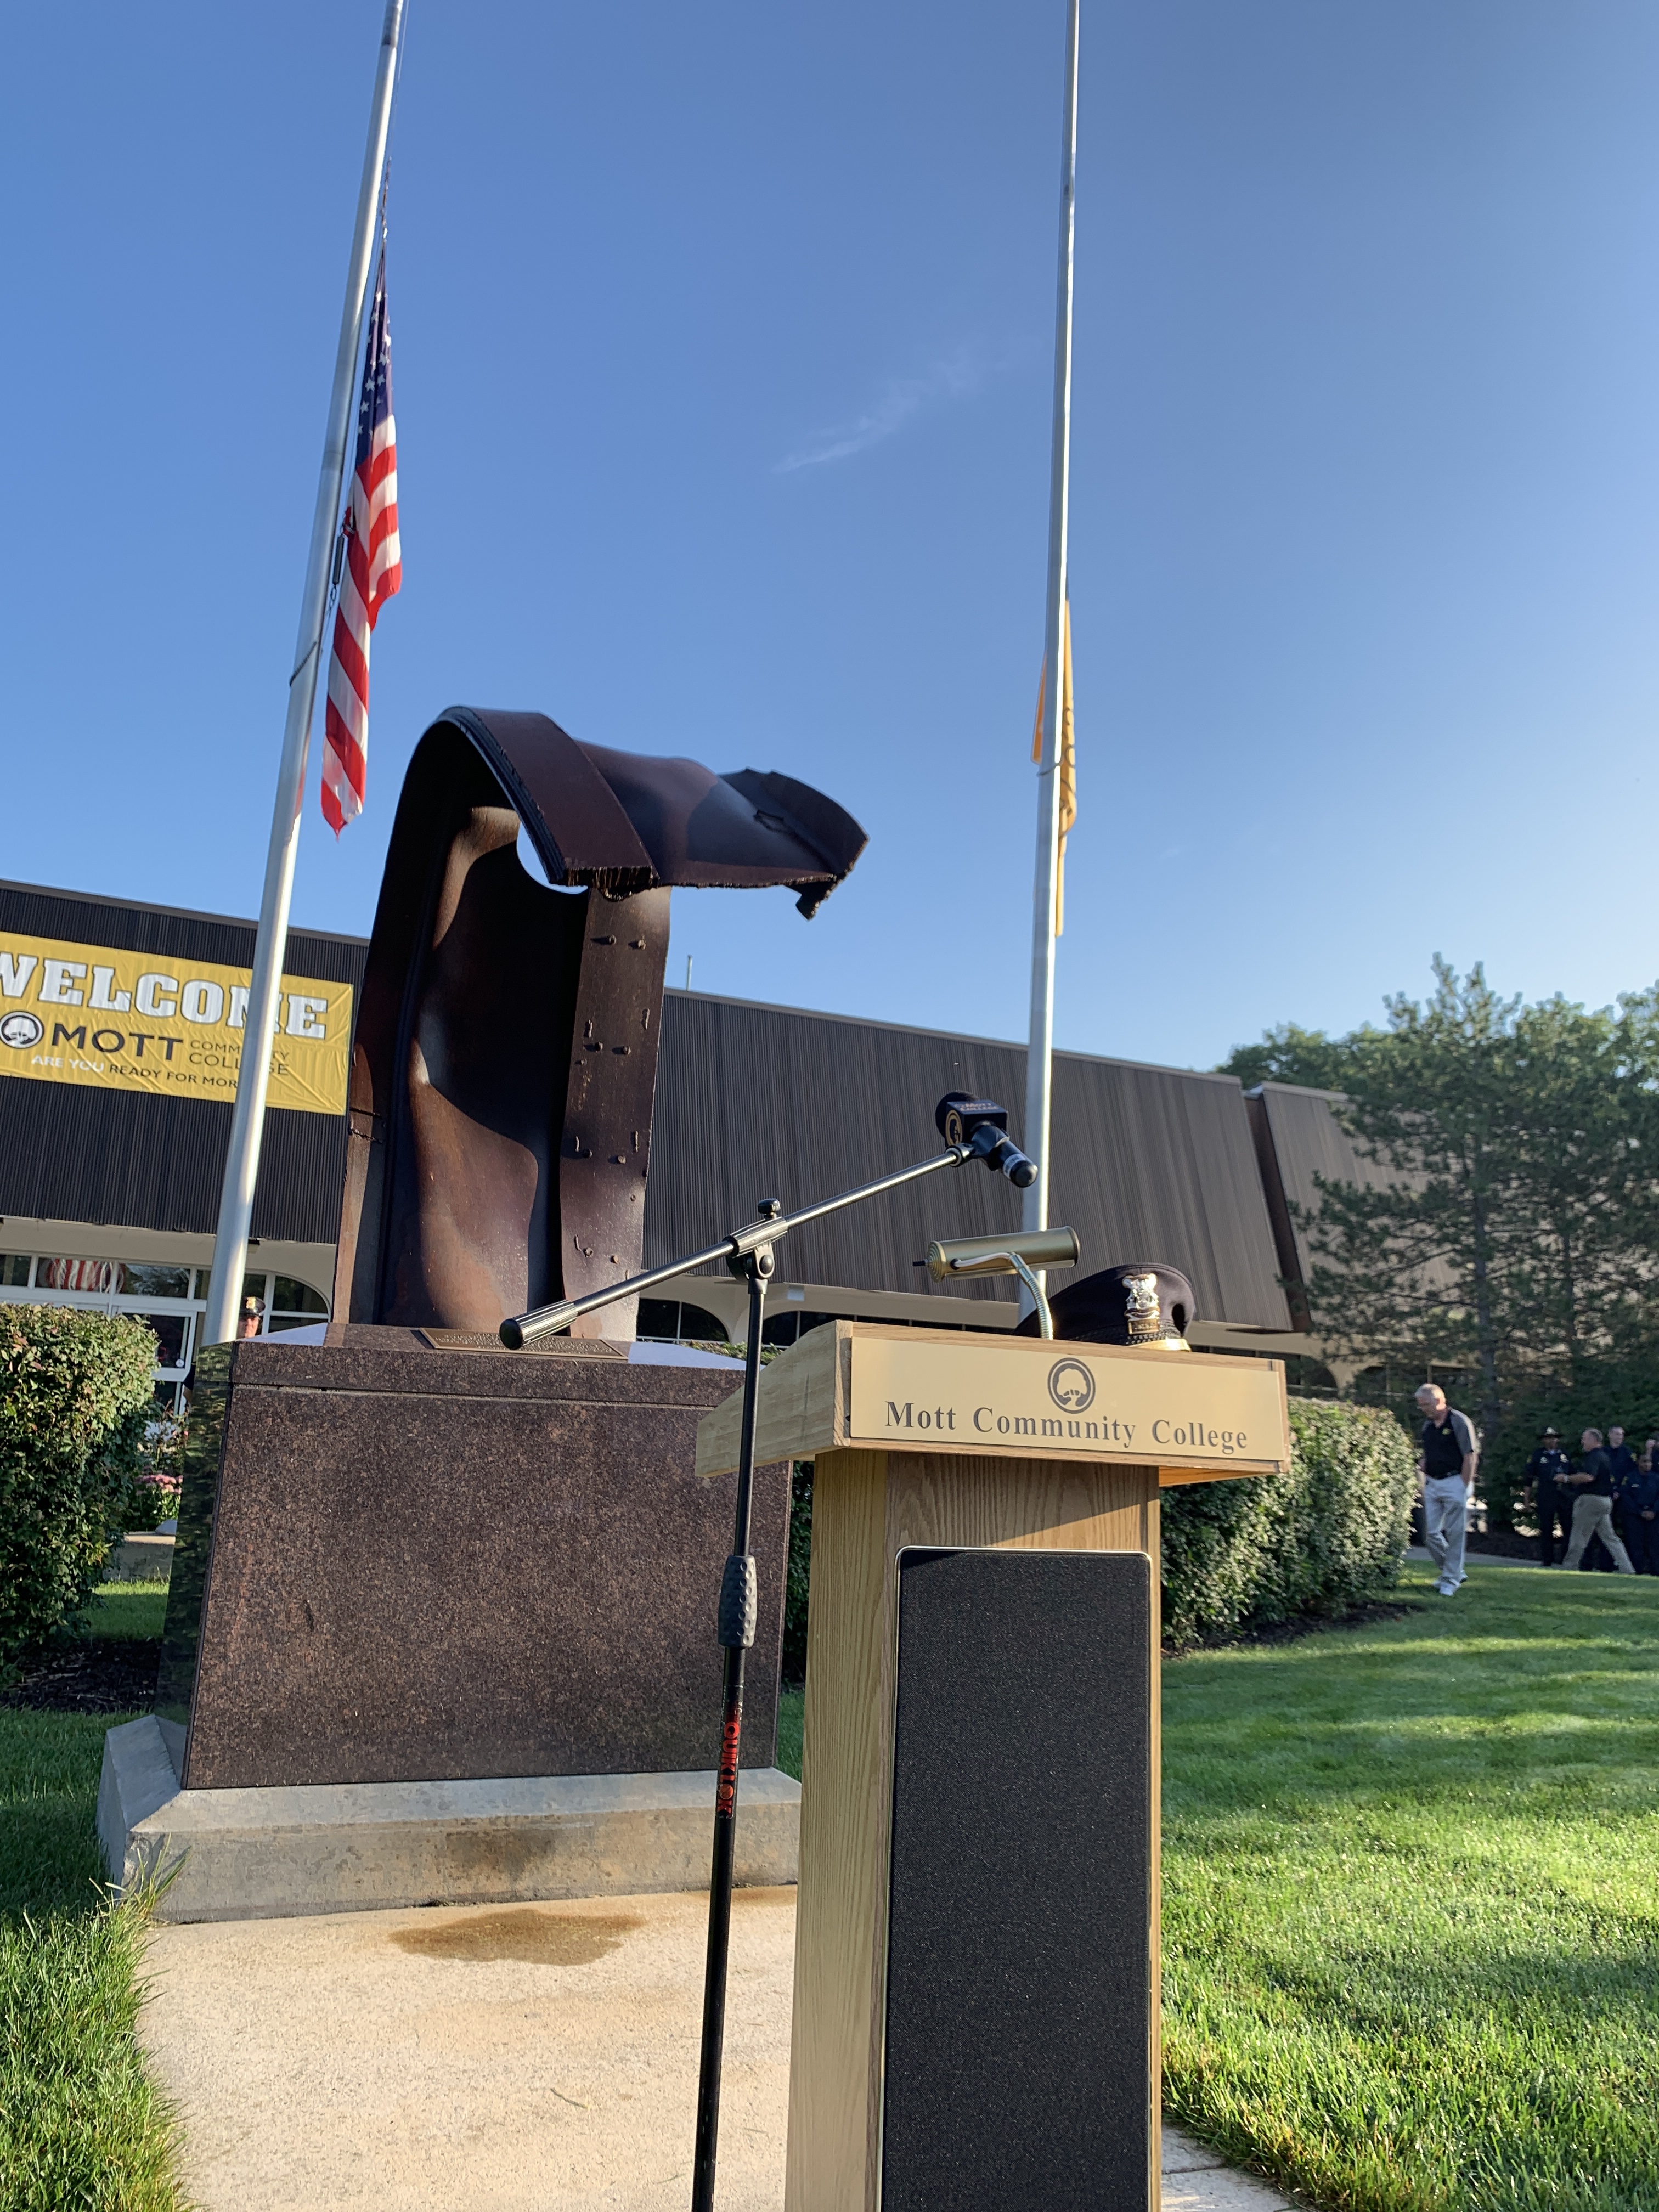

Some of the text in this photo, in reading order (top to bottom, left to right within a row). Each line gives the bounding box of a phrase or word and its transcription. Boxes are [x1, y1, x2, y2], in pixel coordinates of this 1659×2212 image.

[52, 1023, 183, 1061] MOTT
[190, 1039, 289, 1060] COMMTY
[31, 1054, 238, 1088] ARE YOU READY FOR MOR
[189, 1052, 290, 1076] COLLE
[884, 1401, 1248, 1455] Mott Community College
